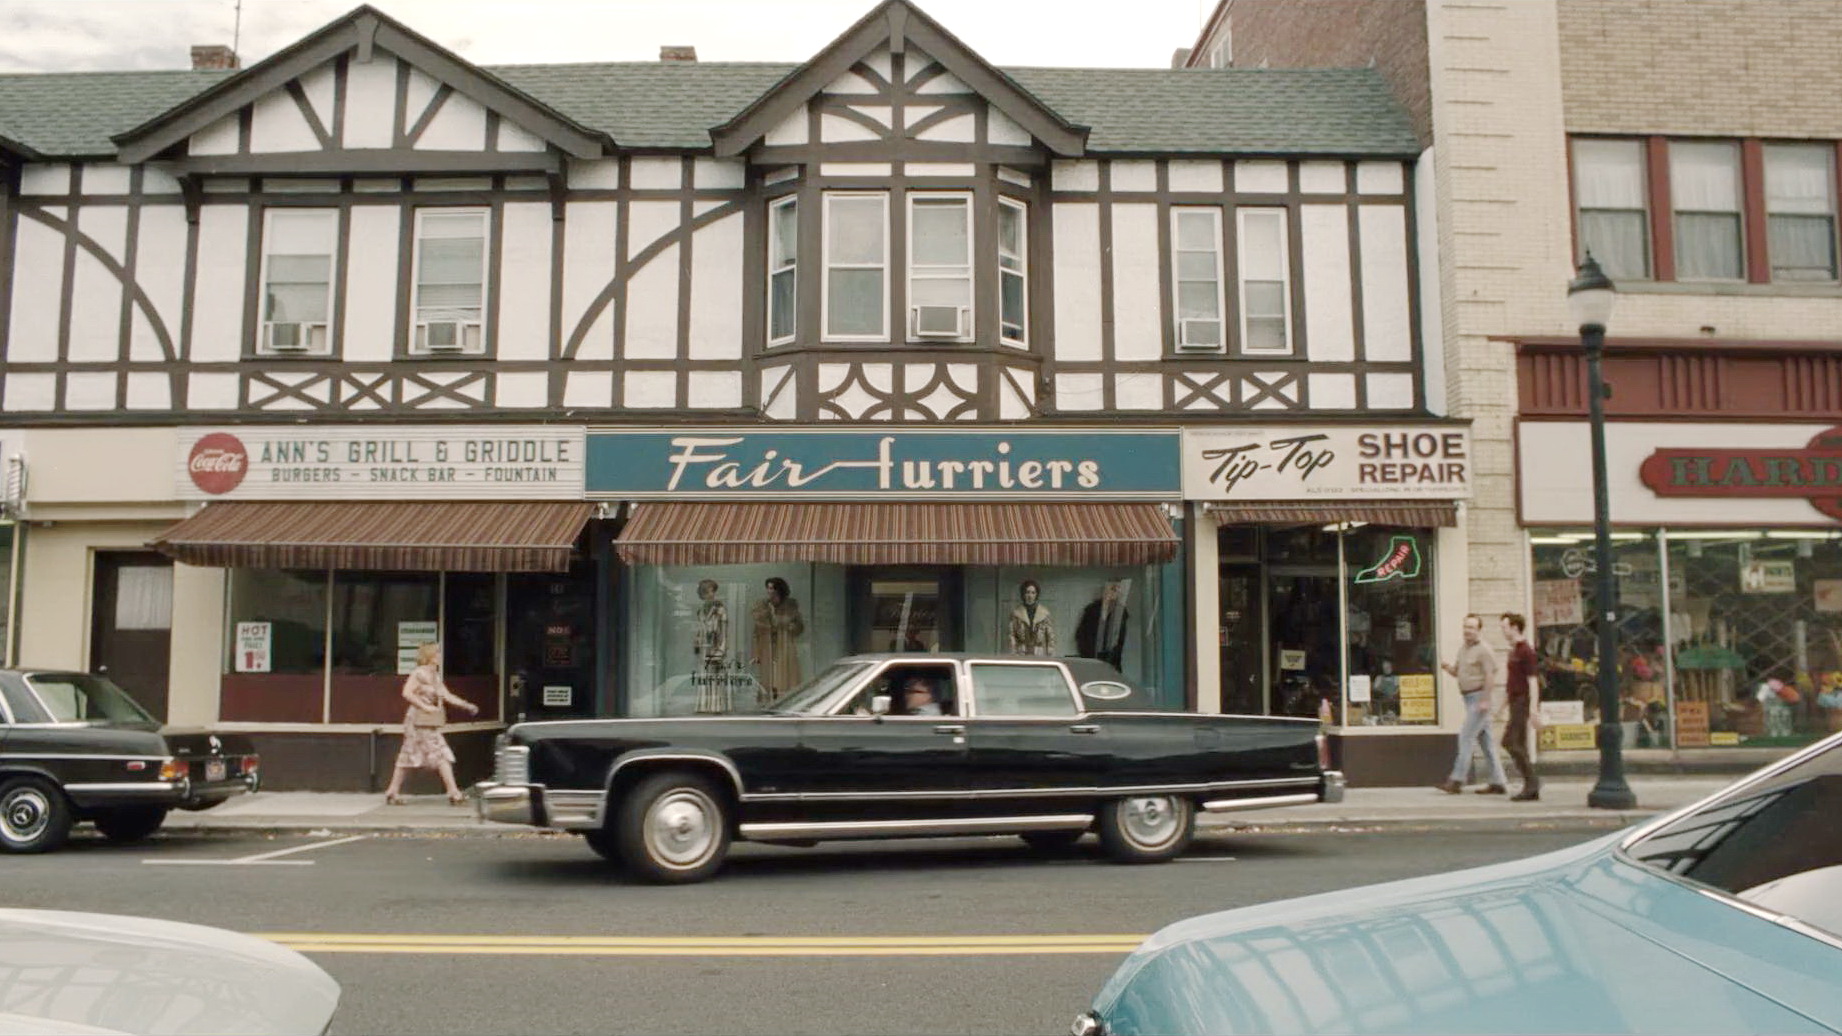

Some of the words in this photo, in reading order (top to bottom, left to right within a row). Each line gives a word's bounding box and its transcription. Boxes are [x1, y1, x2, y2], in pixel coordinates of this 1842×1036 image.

[260, 440, 331, 464] ANN'S
[348, 440, 419, 464] GRILL
[435, 439, 448, 463] &
[464, 439, 571, 463] GRIDDLE
[1357, 433, 1466, 459] SHOE
[271, 467, 341, 483] BURGERS
[369, 467, 419, 483] SNACK
[427, 467, 456, 483] BAR
[484, 467, 558, 482] FOUNTAIN
[667, 436, 840, 491] Fair
[877, 436, 1100, 490] furriers
[1201, 433, 1336, 493] Tip-Top
[1358, 462, 1466, 484] REPAIR
[241, 624, 268, 636] HOT
